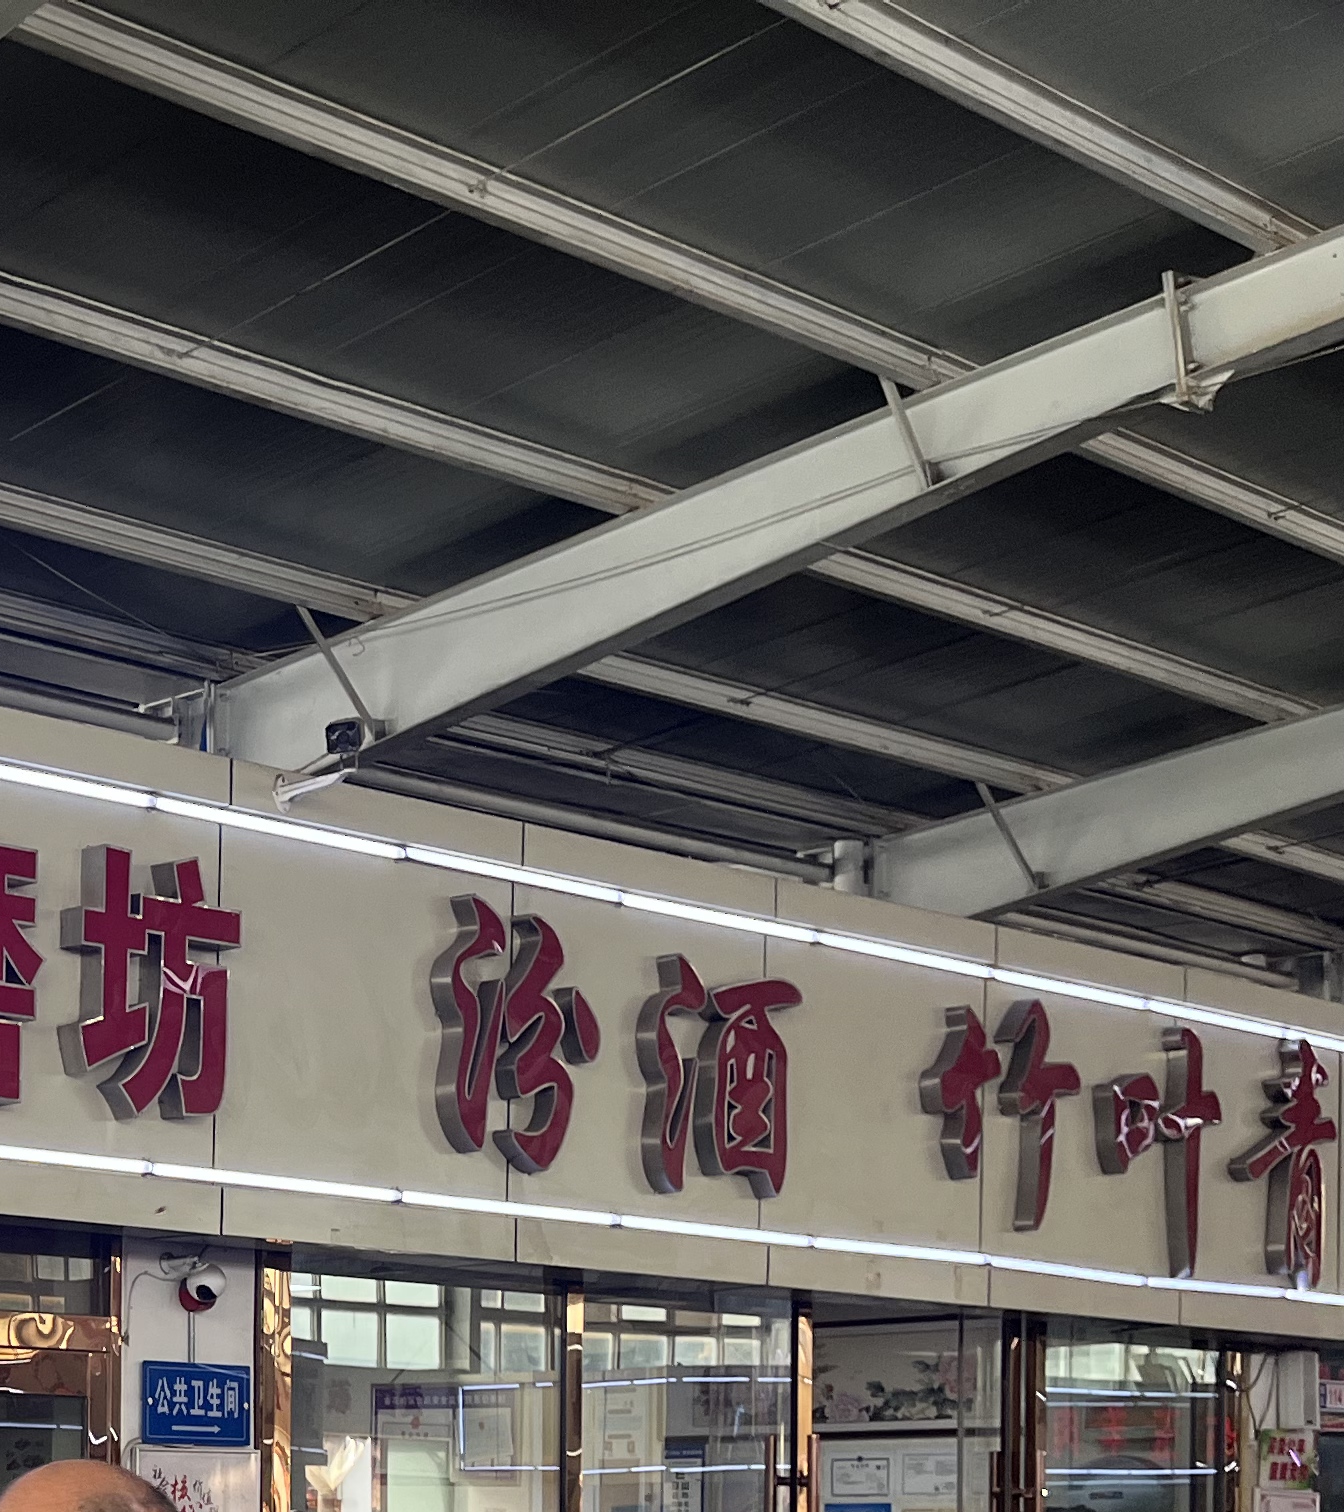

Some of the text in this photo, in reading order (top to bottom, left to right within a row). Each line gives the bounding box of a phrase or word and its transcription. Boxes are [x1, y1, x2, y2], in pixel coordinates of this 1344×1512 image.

[430, 892, 803, 1199] 汾酒
[920, 999, 1337, 1289] 竹叶青
[153, 1376, 241, 1420] 公共卫生间
